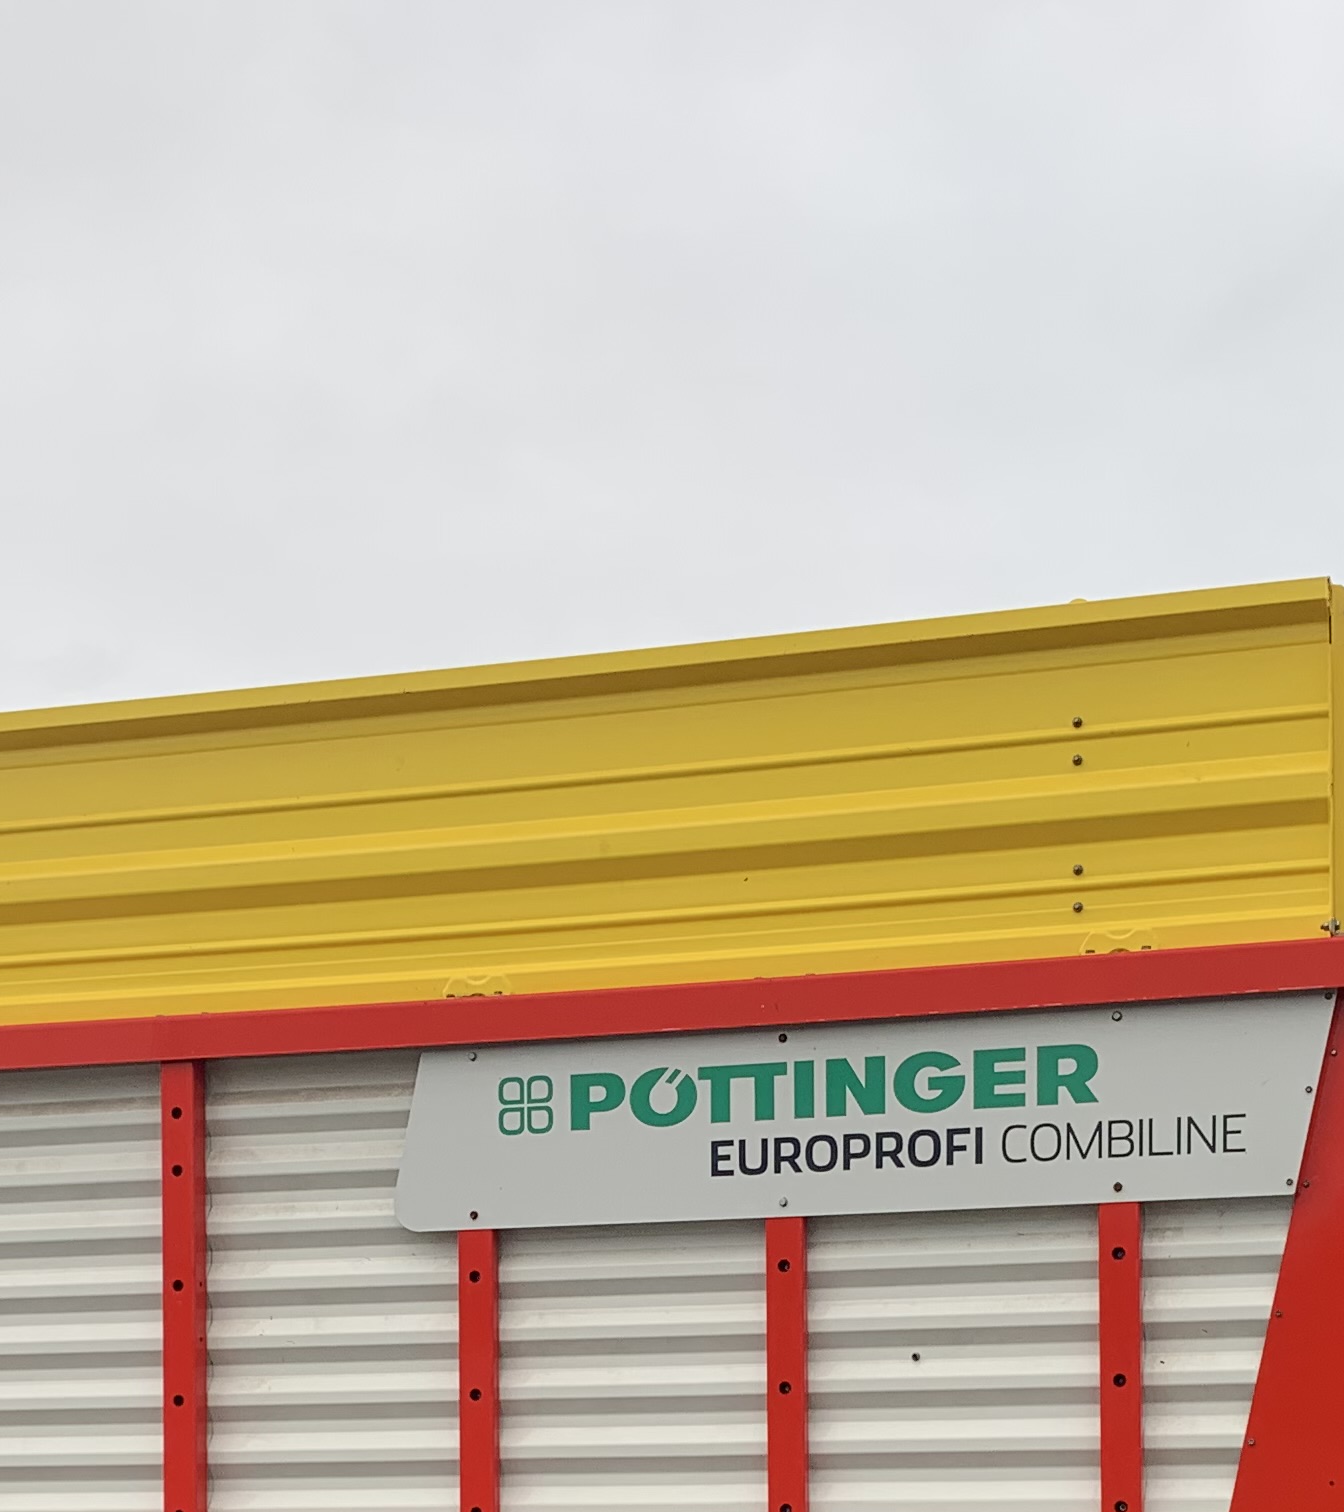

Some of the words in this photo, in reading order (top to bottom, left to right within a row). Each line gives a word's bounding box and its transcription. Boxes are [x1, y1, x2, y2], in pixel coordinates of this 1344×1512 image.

[570, 1043, 1099, 1132] PÖTTINGER
[710, 1127, 983, 1177] EUROPROFI
[1000, 1114, 1247, 1163] COMBILINE
